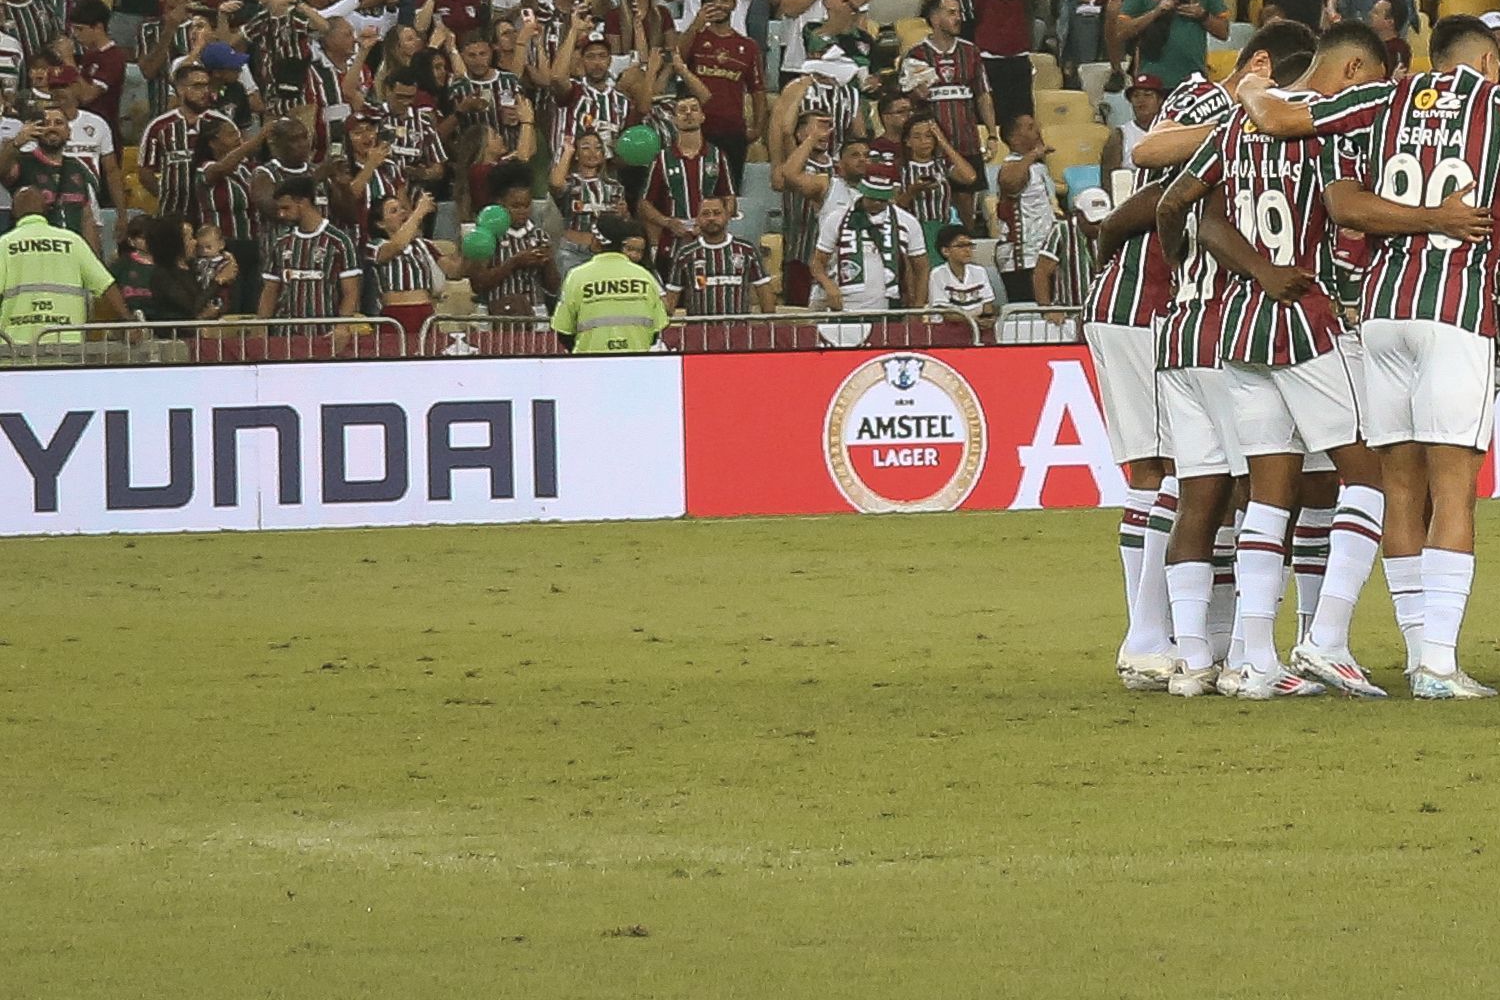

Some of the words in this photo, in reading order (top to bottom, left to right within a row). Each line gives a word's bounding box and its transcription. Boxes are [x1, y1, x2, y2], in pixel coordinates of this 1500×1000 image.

[1400, 126, 1464, 147] SERNA
[1235, 190, 1294, 266] 19
[9, 240, 72, 255] SUNSET
[583, 280, 650, 298] SUNSET
[856, 415, 954, 439] AMSTEL
[872, 448, 939, 467] LAGER
